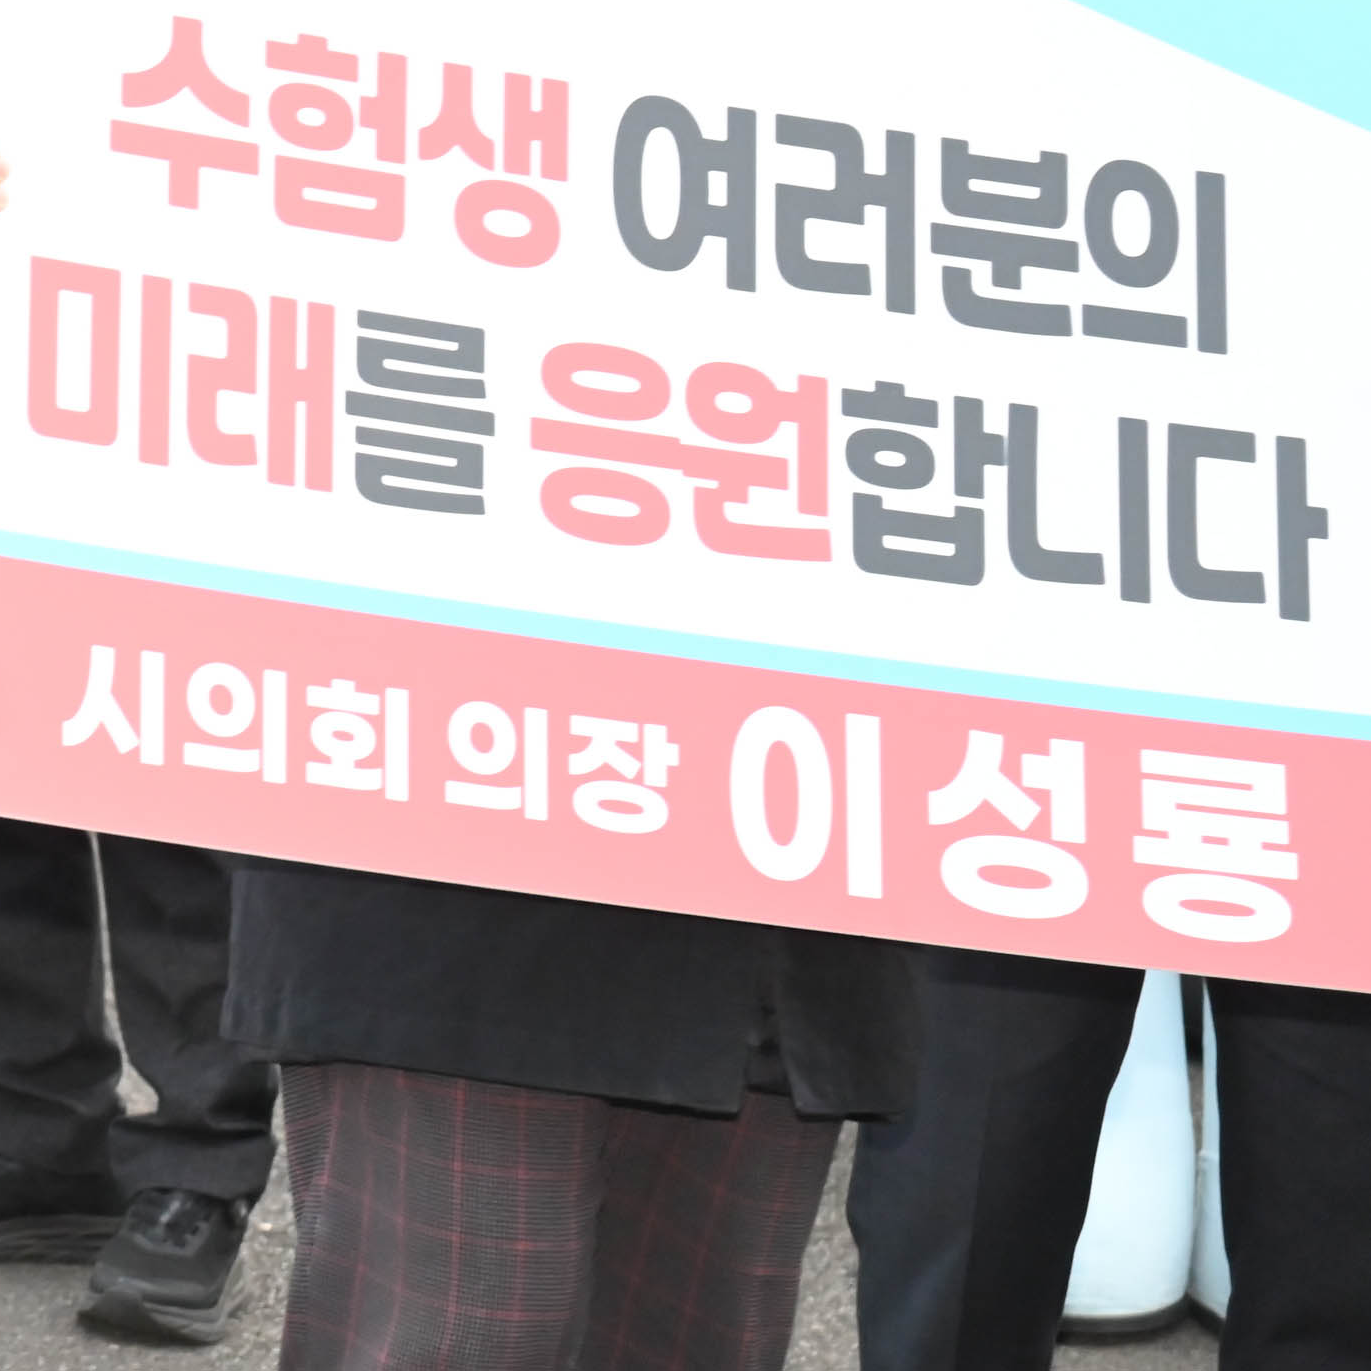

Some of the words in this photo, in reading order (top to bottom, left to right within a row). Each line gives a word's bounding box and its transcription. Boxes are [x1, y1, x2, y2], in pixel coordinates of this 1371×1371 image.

[110, 15, 570, 269] 수험생
[611, 94, 1229, 355] 여러분의
[27, 255, 495, 515] 미래를
[531, 342, 1330, 623] 응원합니다
[62, 644, 409, 802] 시의회
[445, 701, 679, 834] 의장
[730, 704, 1299, 943] 이성룡
